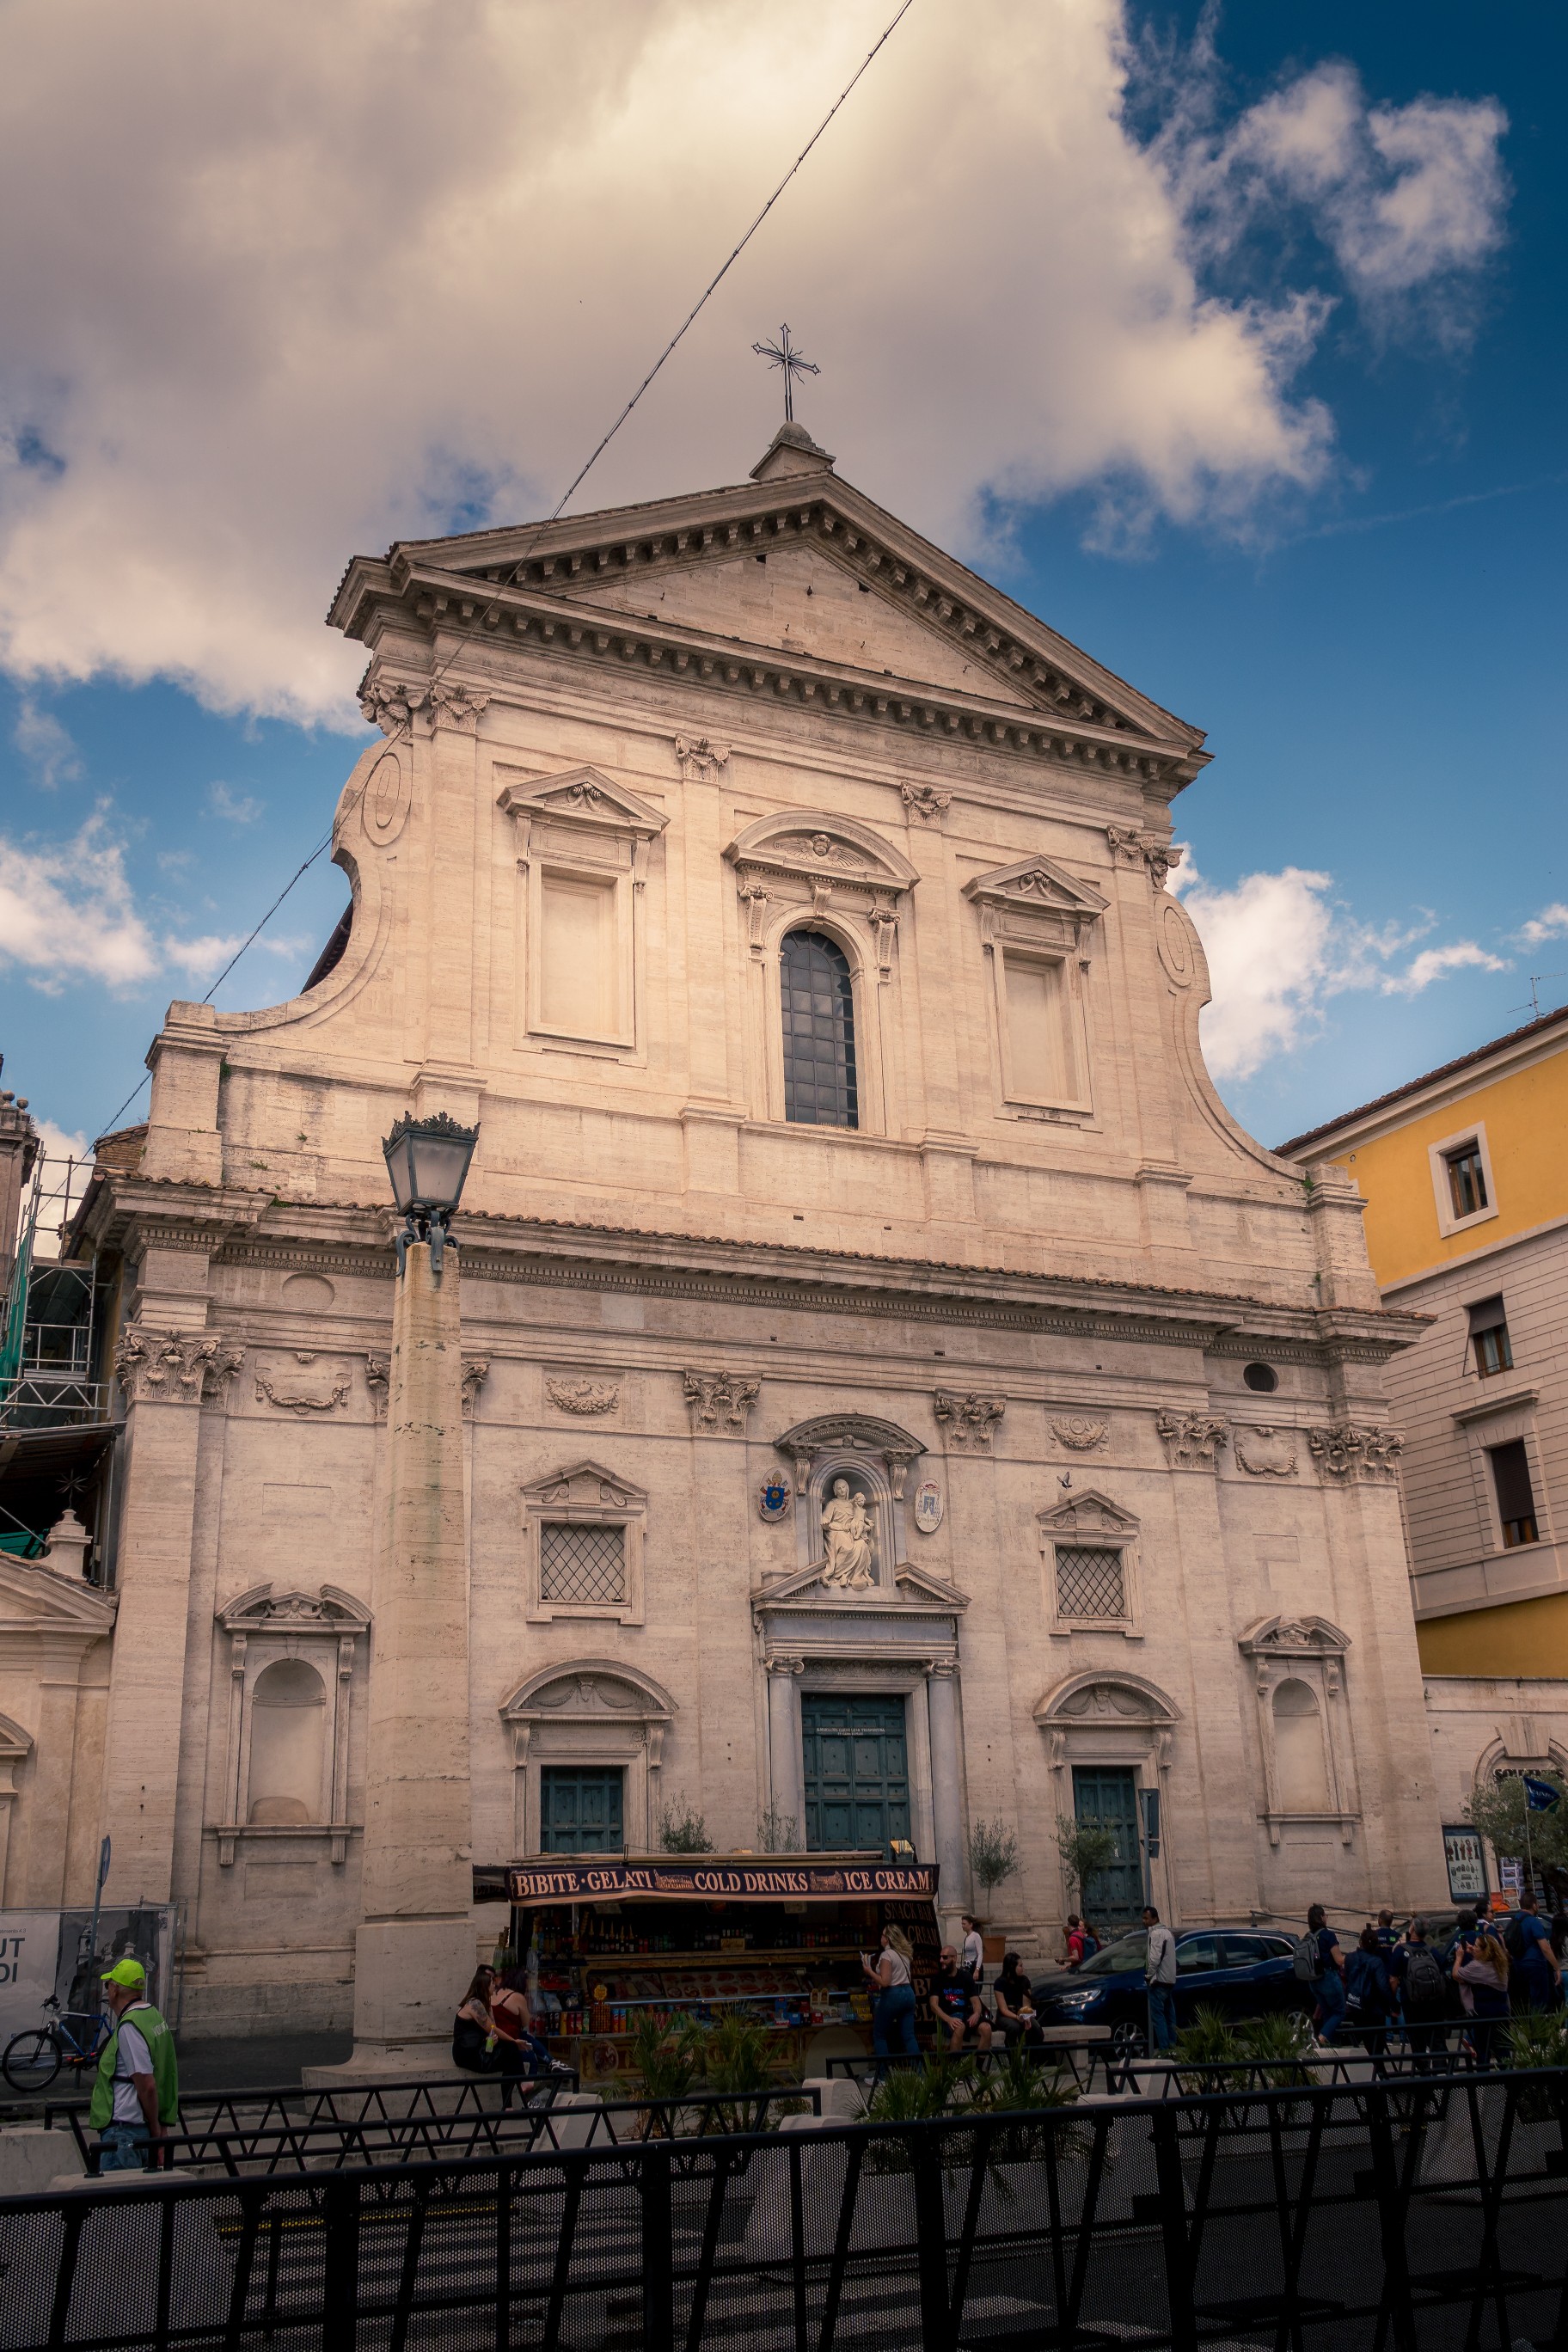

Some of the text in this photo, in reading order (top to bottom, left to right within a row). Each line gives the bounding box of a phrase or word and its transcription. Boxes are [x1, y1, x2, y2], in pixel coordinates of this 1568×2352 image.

[517, 1871, 653, 1897] BIBITE GELATI
[695, 1871, 808, 1891] COLD DRINKS
[843, 1871, 930, 1891] ICE CREAM
[885, 1902, 934, 1921] SNACK BAR
